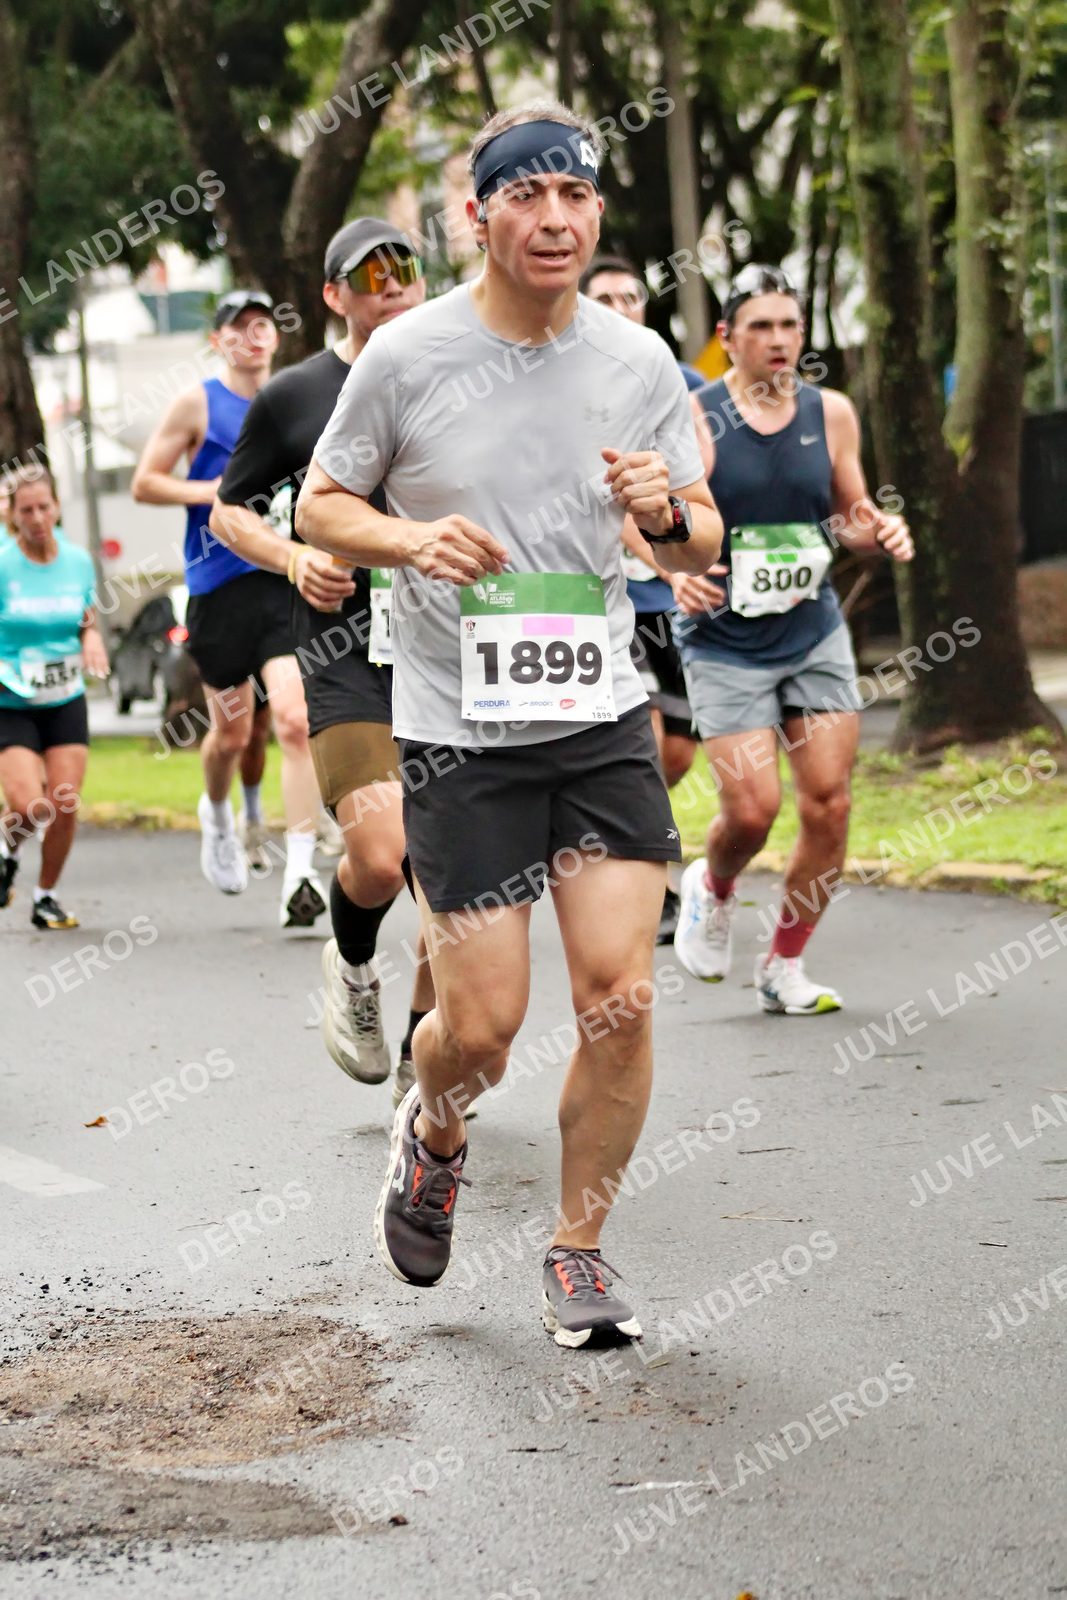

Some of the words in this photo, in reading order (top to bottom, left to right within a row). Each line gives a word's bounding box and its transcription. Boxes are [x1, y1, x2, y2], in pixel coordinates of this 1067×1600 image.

[752, 566, 812, 593] 800
[476, 640, 602, 685] 1899
[473, 699, 511, 708] PERDURA
